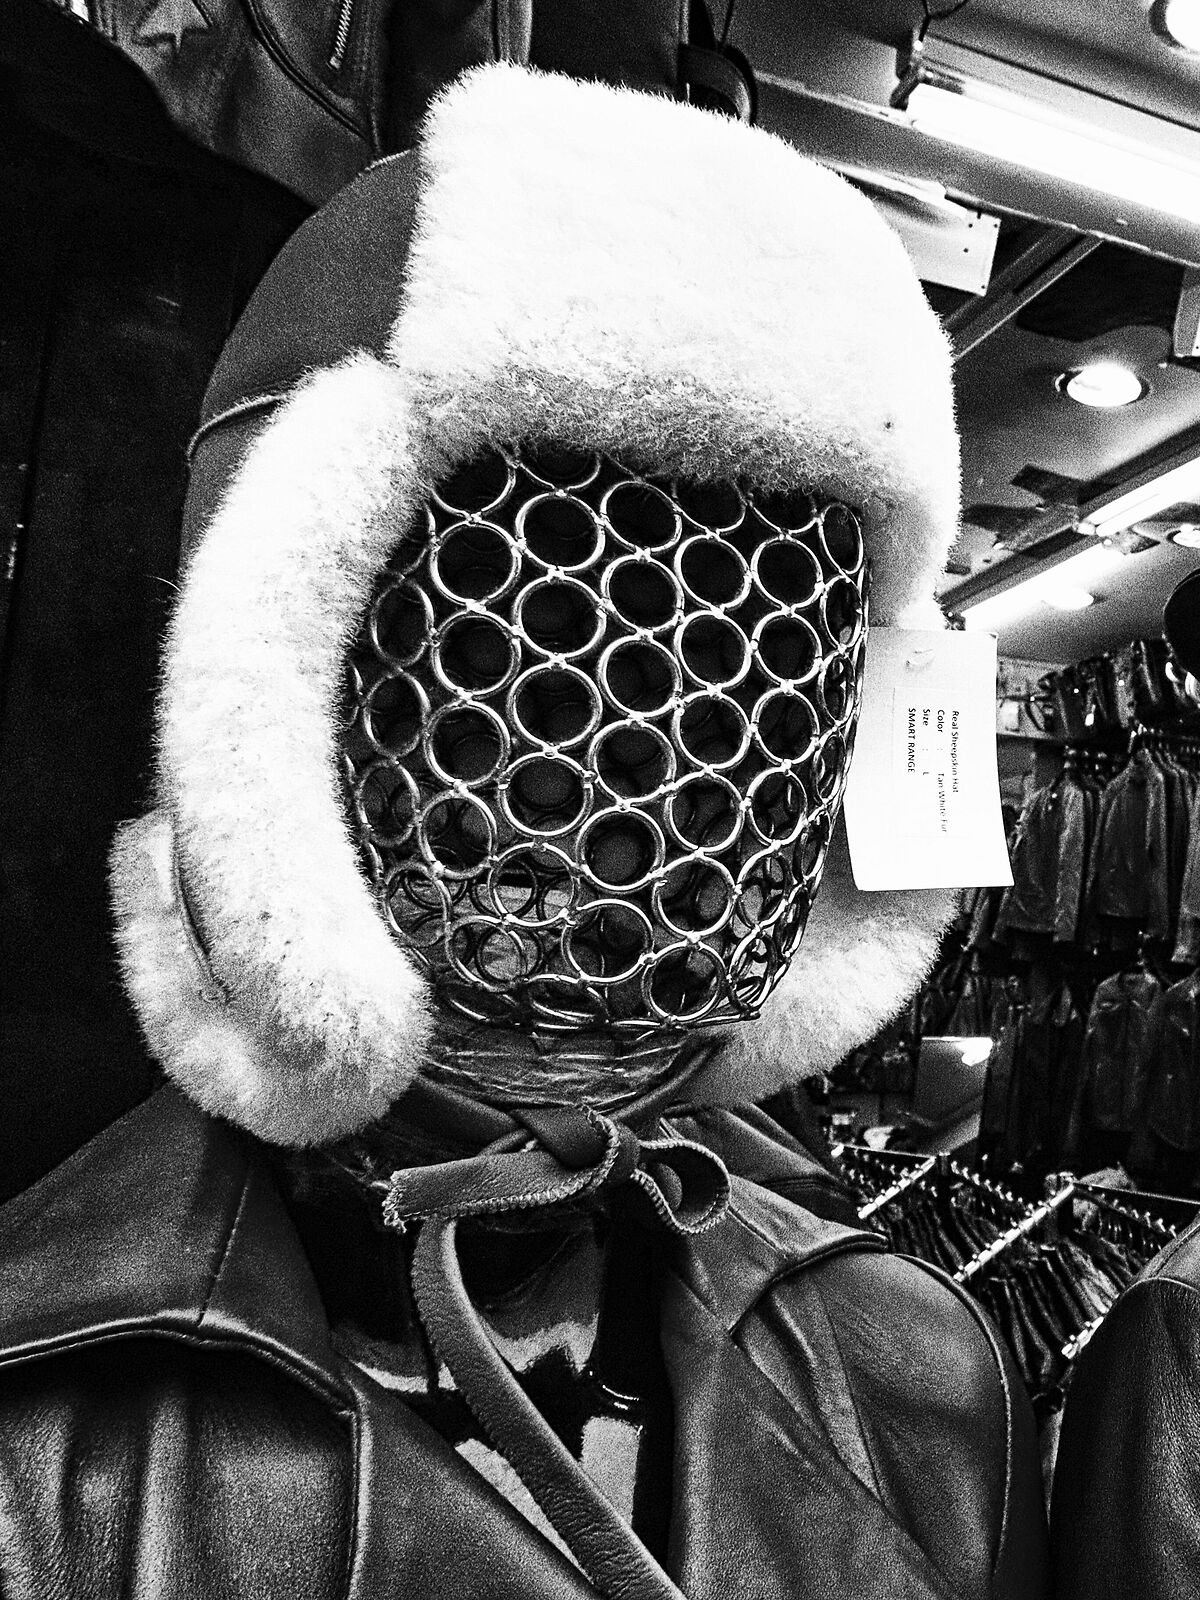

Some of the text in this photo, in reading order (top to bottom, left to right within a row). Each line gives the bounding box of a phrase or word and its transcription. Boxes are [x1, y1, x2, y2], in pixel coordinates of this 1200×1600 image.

[908, 708, 916, 739] SMART
[922, 708, 930, 726] Size
[937, 710, 945, 733] Color
[951, 711, 959, 729] Real
[950, 732, 959, 776] Sheepskin
[937, 772, 945, 788] Tan
[938, 790, 946, 816] White
